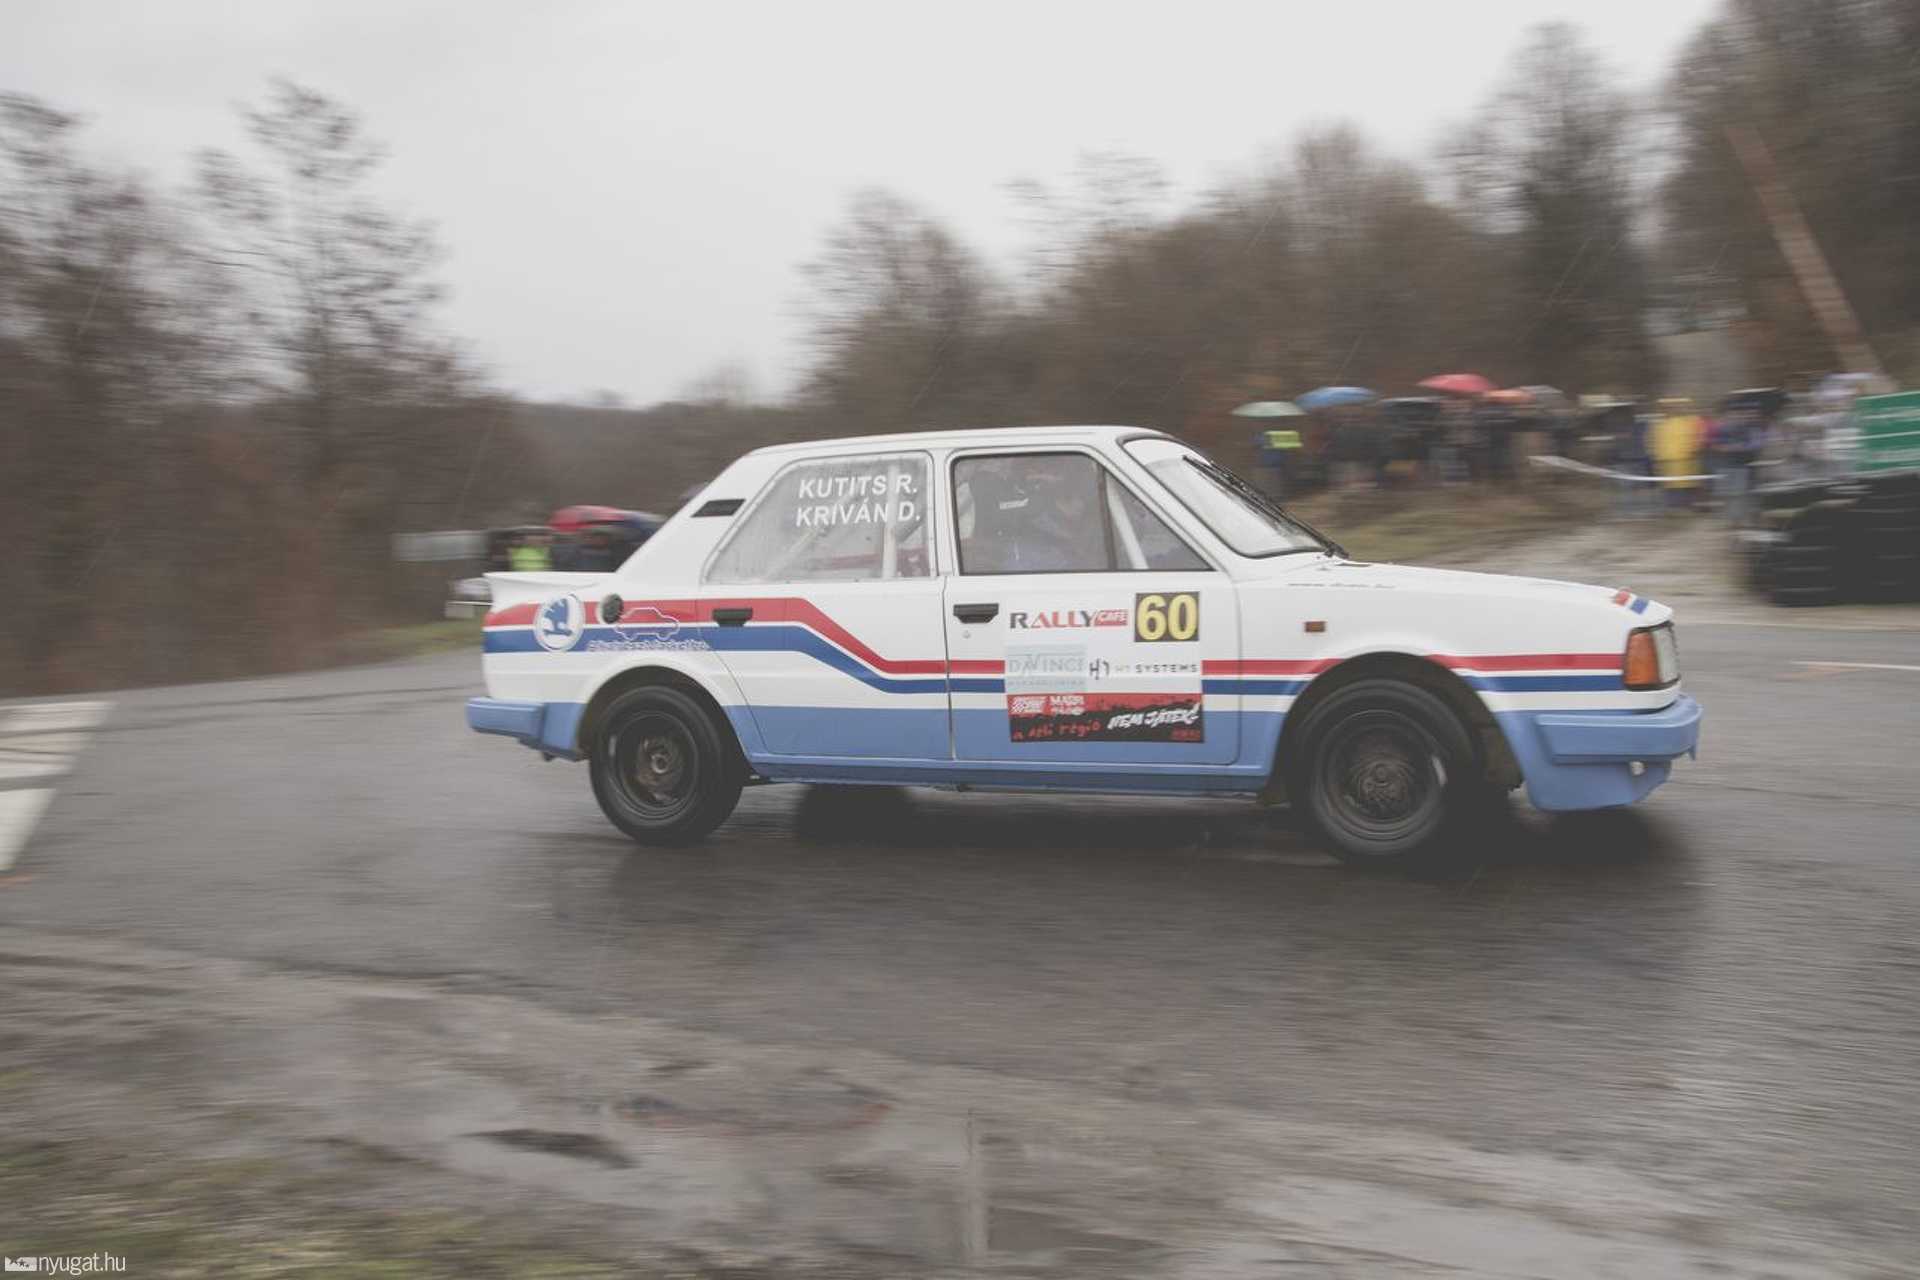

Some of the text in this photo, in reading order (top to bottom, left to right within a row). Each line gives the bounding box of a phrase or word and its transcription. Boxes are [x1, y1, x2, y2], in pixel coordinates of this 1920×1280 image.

[799, 474, 918, 499] KUTITS R.
[898, 501, 920, 522] D.
[1009, 610, 1096, 629] RALLY
[1136, 594, 1198, 641] 60
